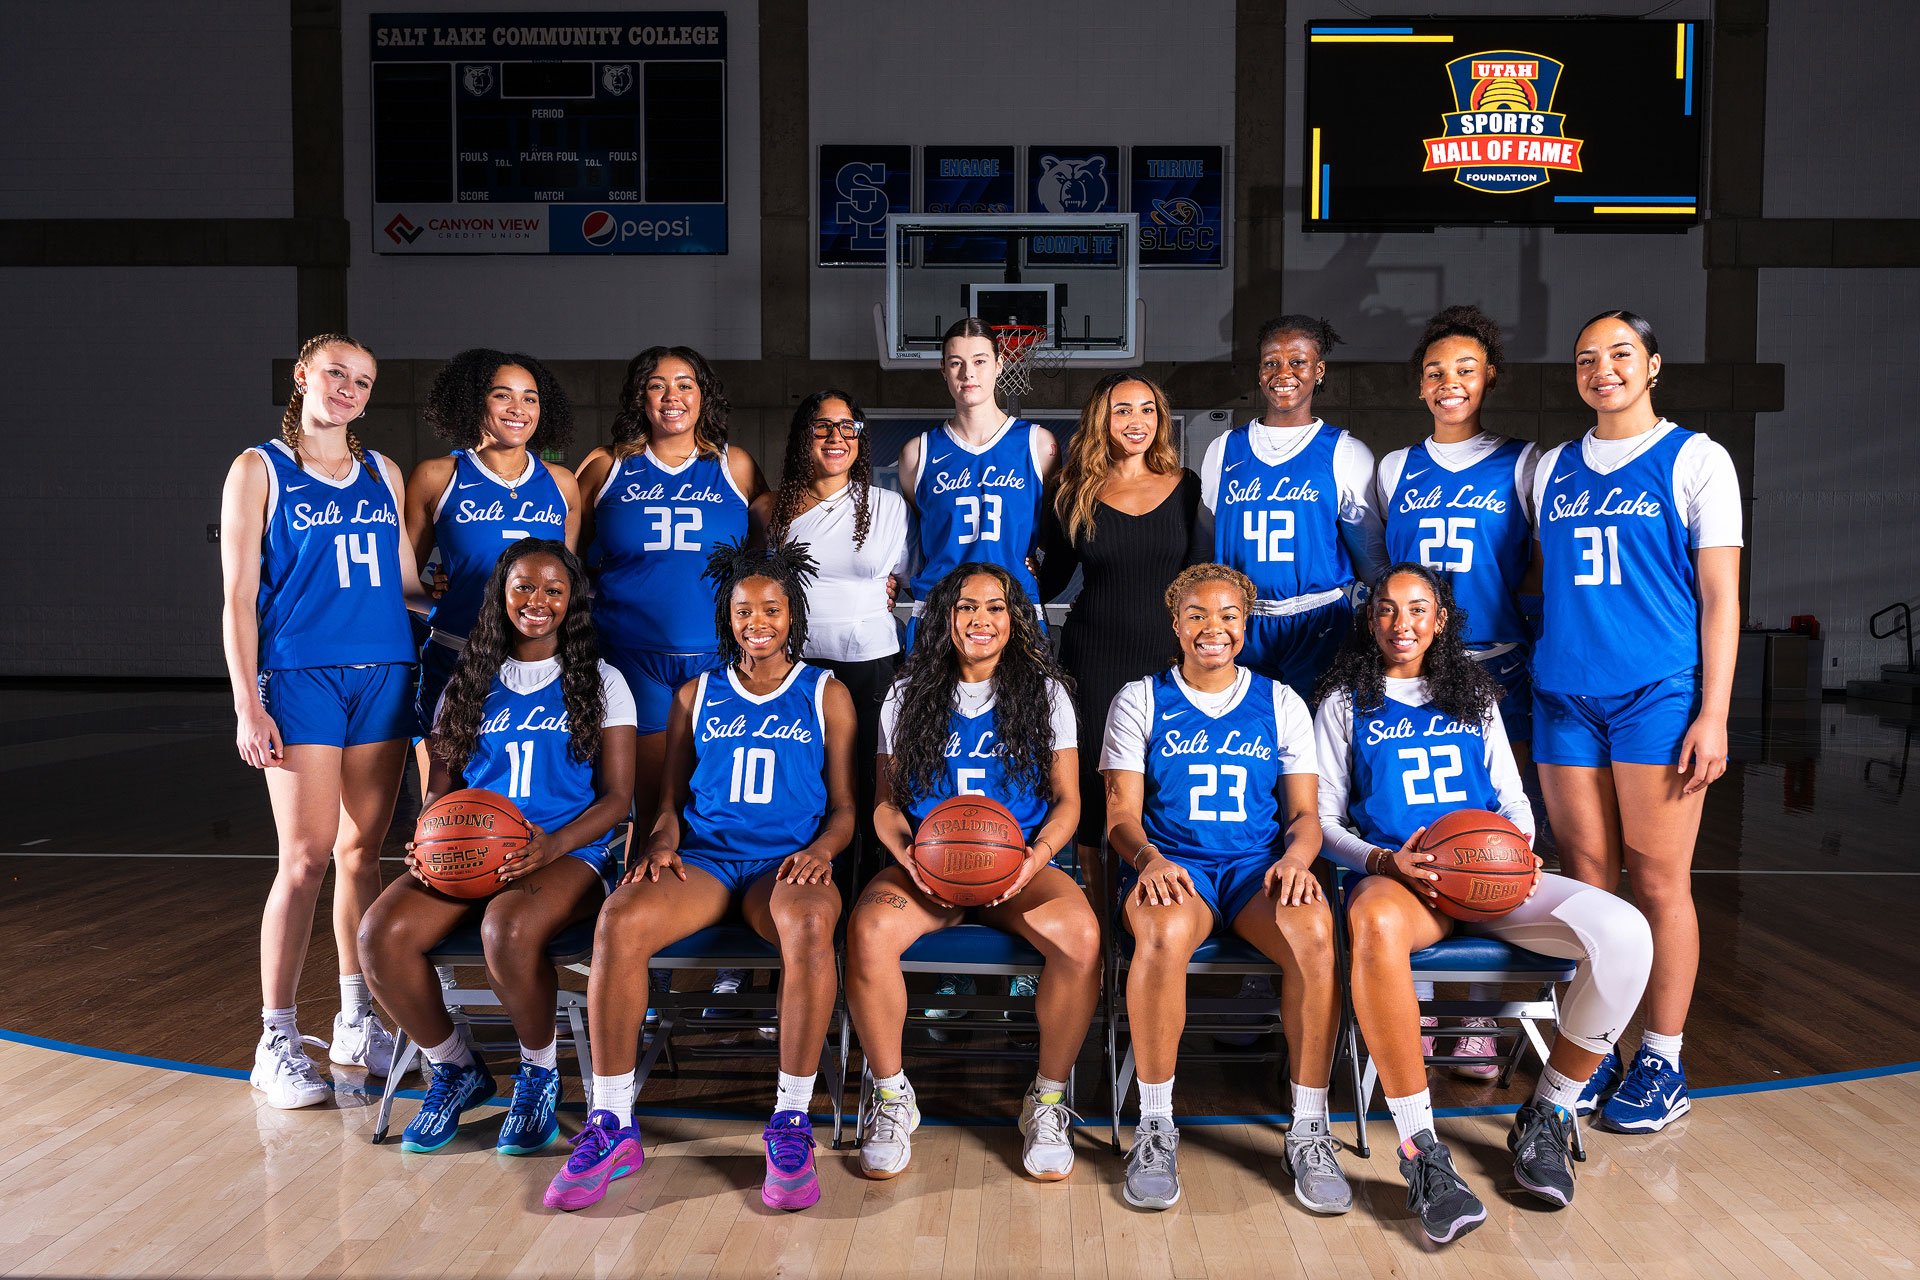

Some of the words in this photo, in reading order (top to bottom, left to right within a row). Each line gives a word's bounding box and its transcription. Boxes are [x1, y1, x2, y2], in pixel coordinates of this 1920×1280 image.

[376, 27, 428, 47] SALT
[432, 27, 487, 46] LAKE
[492, 26, 623, 46] COMMUNITY
[627, 26, 719, 46] COLLEGE
[1477, 64, 1533, 77] UTAH
[531, 108, 564, 119] PERIOD
[1460, 113, 1545, 135] SPORTS
[460, 151, 489, 162] FOULS
[520, 151, 553, 162] PLAYER
[556, 151, 579, 161] FOUL
[608, 151, 638, 161] FOULS
[1431, 140, 1482, 164] HALL
[1487, 139, 1513, 161] OF
[1517, 140, 1574, 165] FAME
[939, 158, 1000, 177] ENGAGE
[1146, 159, 1204, 178] THRIVE
[1466, 173, 1537, 182] FOUNDATION
[460, 191, 489, 200] SCORE
[534, 191, 564, 200] MATCH
[608, 191, 638, 200] SCORE
[428, 218, 494, 231] CANYON
[498, 218, 540, 231] VIEW
[621, 215, 690, 242] pepsi
[1033, 235, 1113, 254] COMPLTE
[1139, 226, 1215, 251] SLCC
[933, 466, 972, 495] Salt
[977, 465, 1025, 490] Lake
[1225, 476, 1262, 505] Salt
[1267, 476, 1320, 502] Lake
[621, 483, 665, 503] Salt
[670, 483, 723, 504] Lake
[1400, 485, 1443, 514] Salt
[1446, 484, 1506, 513] Lake
[1549, 489, 1591, 522] Salt
[1594, 487, 1661, 518] Lake
[292, 502, 344, 531] Salt
[350, 499, 398, 527] Lake
[455, 499, 506, 524] Salt
[512, 501, 563, 526] Lake
[955, 493, 1003, 545] 33
[643, 506, 703, 551] 32
[1243, 510, 1295, 562] 42
[1418, 517, 1476, 573] 25
[1573, 525, 1622, 586] 31
[334, 532, 381, 589] 14
[475, 707, 512, 735] alt
[516, 705, 573, 735] Lak
[701, 714, 747, 743] Salt
[751, 714, 812, 744] Lake
[1366, 717, 1416, 746] Salt
[1422, 715, 1481, 737] Lake
[1161, 729, 1210, 758] Salt
[1216, 729, 1272, 761] Lake
[505, 740, 534, 798] 11
[729, 746, 776, 804] 10
[1397, 744, 1468, 806] 22
[1188, 763, 1248, 823] 23
[421, 813, 495, 835] SPALDING
[932, 819, 1009, 842] SPALDING
[423, 845, 489, 864] LEGACY
[1453, 846, 1530, 867] SPALDING
